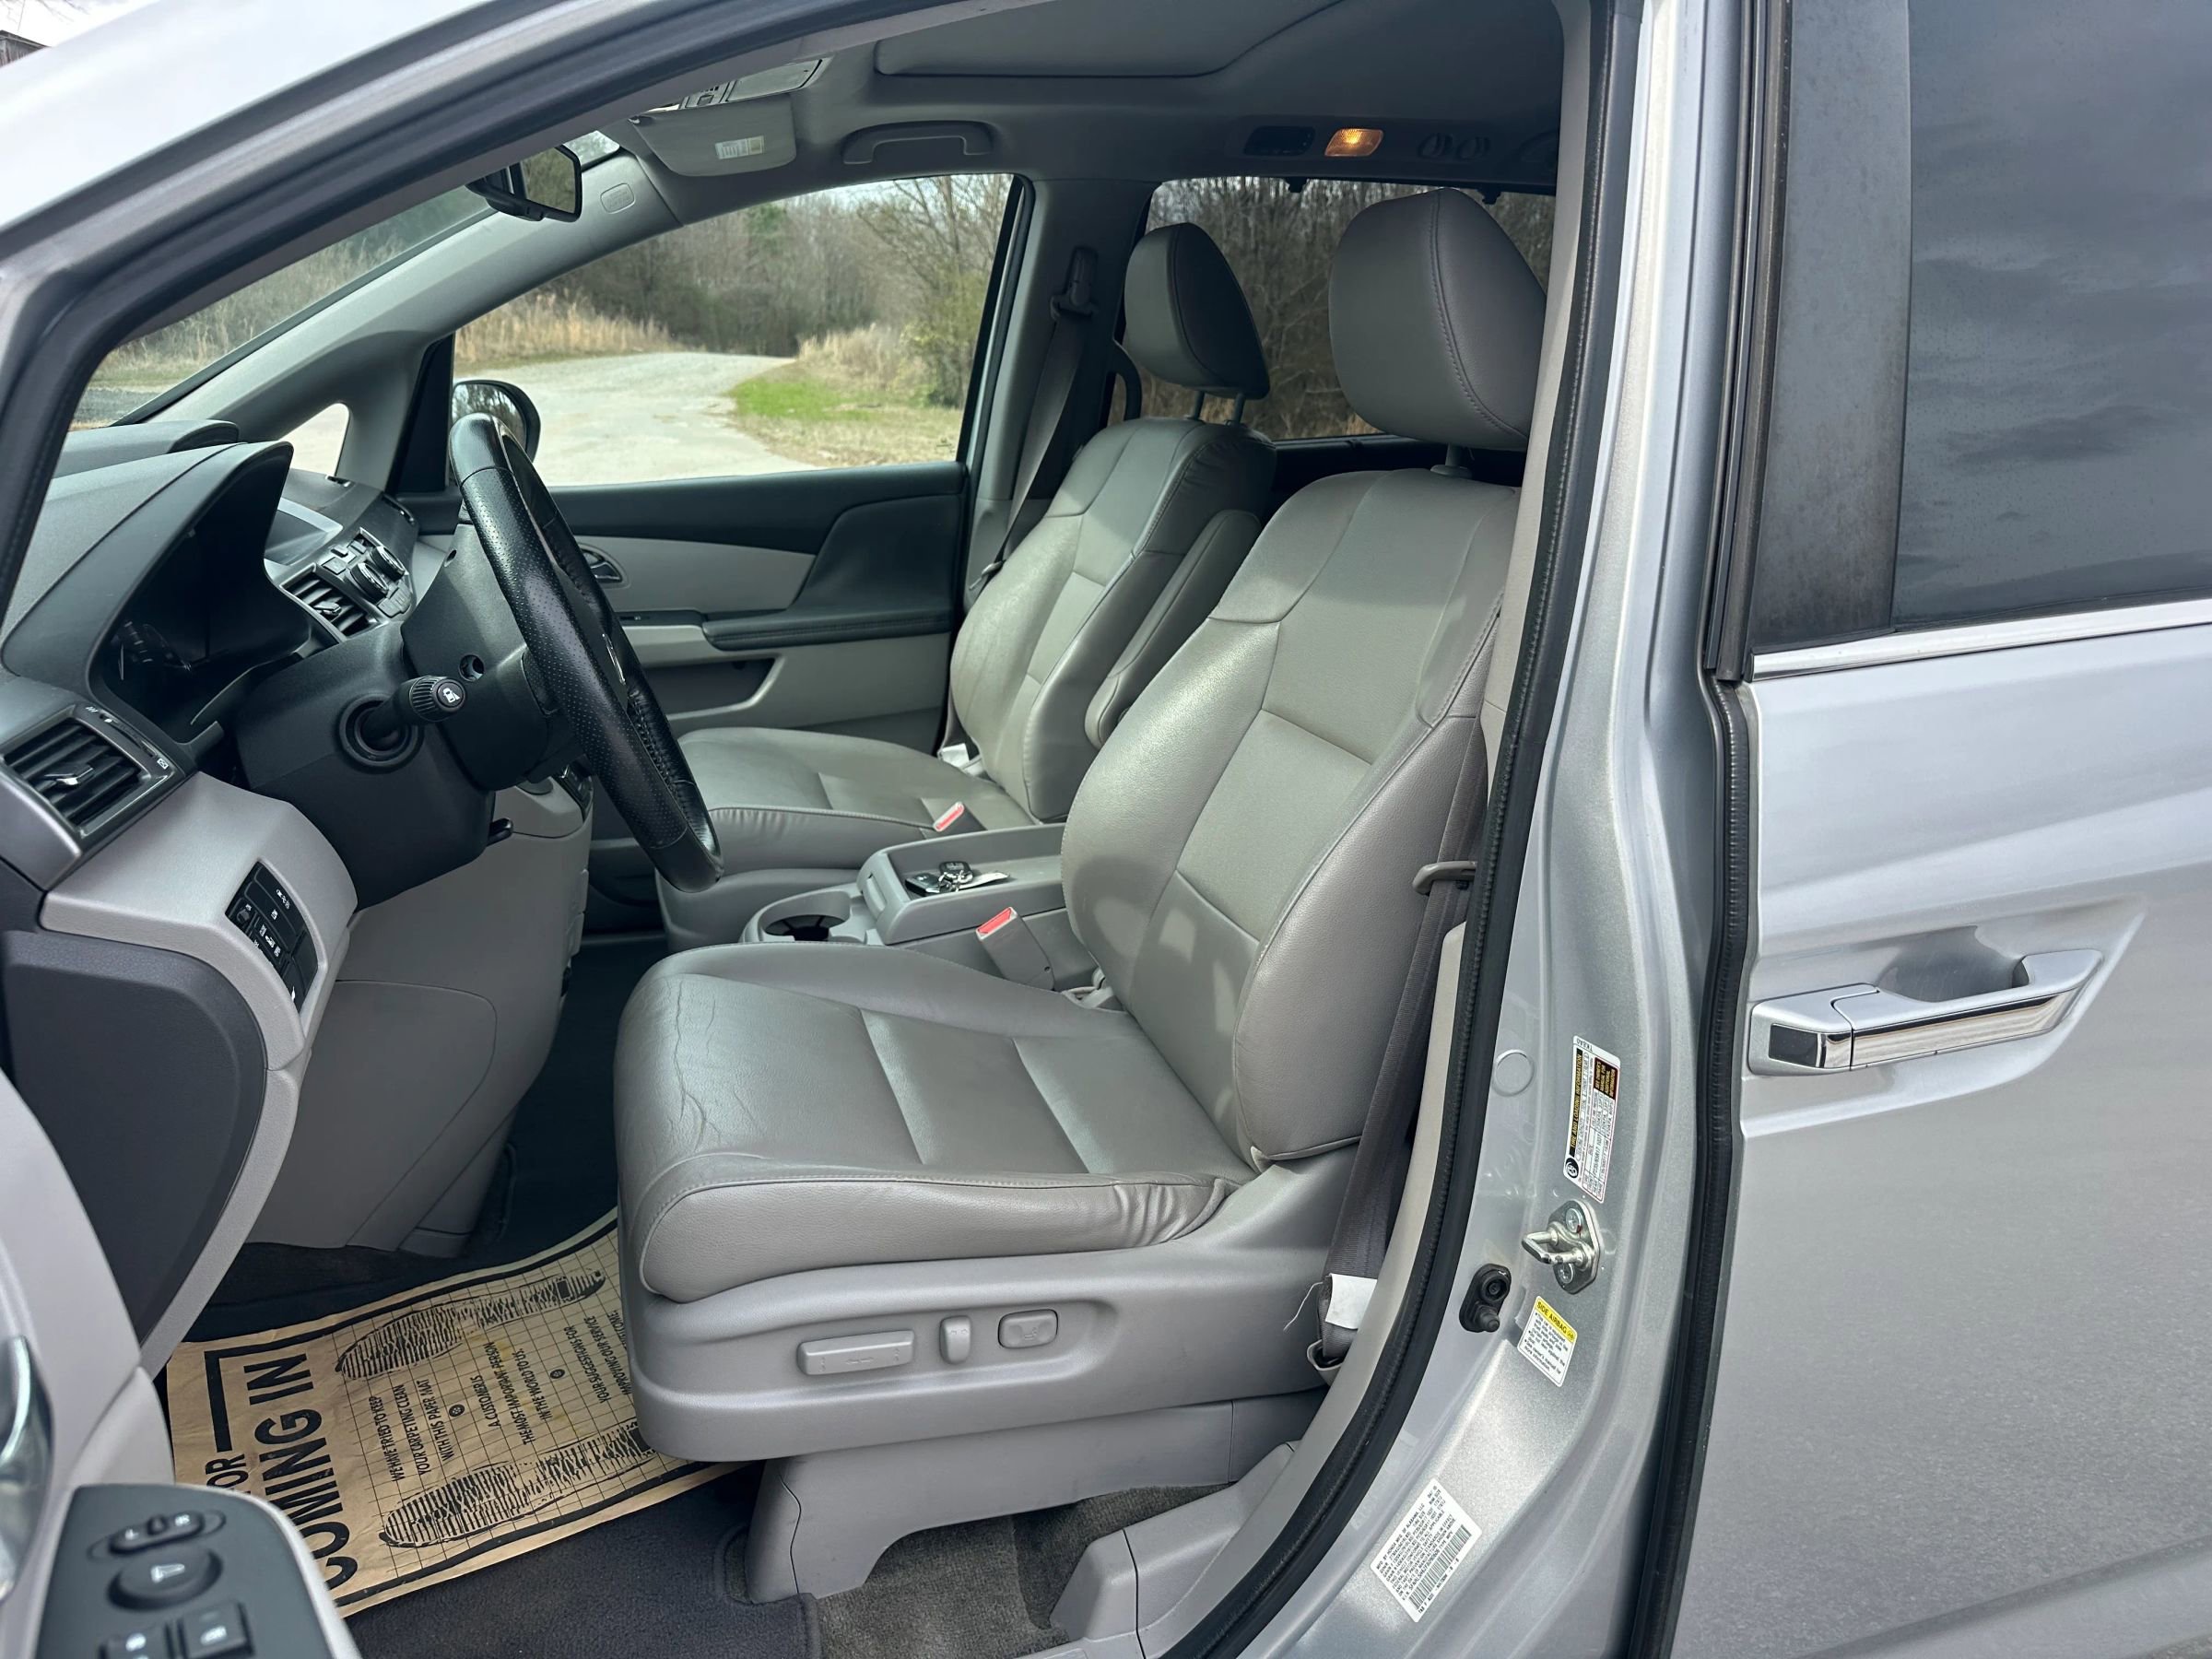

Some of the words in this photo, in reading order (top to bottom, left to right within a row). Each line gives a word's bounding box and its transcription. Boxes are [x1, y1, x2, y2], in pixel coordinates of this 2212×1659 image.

[583, 1315, 606, 1342] SERVICE
[1536, 1301, 1549, 1315] SIDE
[1549, 1313, 1567, 1334] AIRBAG
[564, 1324, 578, 1339] FOR
[483, 1342, 504, 1369] PERSON
[512, 1348, 526, 1361] US.
[596, 1341, 614, 1357] OUR
[517, 1360, 531, 1371] TO
[570, 1338, 602, 1383] SUGGESTIONS
[243, 1353, 314, 1406] IN
[471, 1375, 484, 1384] IS
[522, 1370, 542, 1396] WORLD
[605, 1356, 631, 1395] IMPROVING
[393, 1384, 410, 1408] CLEAN
[417, 1379, 433, 1396] MAT
[494, 1369, 523, 1409] IMPORTANT
[592, 1382, 612, 1404] YOUR
[369, 1395, 384, 1414] KEEP
[423, 1396, 441, 1420] PAPER
[474, 1382, 498, 1420] CUSTOMER
[532, 1395, 549, 1412] THE
[373, 1413, 386, 1427] TO
[488, 1419, 501, 1428] A
[511, 1410, 530, 1430] MOST
[538, 1410, 553, 1420] IN
[377, 1424, 395, 1449] TRIED
[399, 1408, 424, 1452] CARPETING
[430, 1420, 448, 1441] THIS
[519, 1429, 536, 1445] THE
[384, 1448, 402, 1468] HAVE
[436, 1438, 454, 1462] WITH
[205, 1453, 251, 1495] OR
[390, 1467, 406, 1482] WE
[414, 1451, 431, 1477] YOUR
